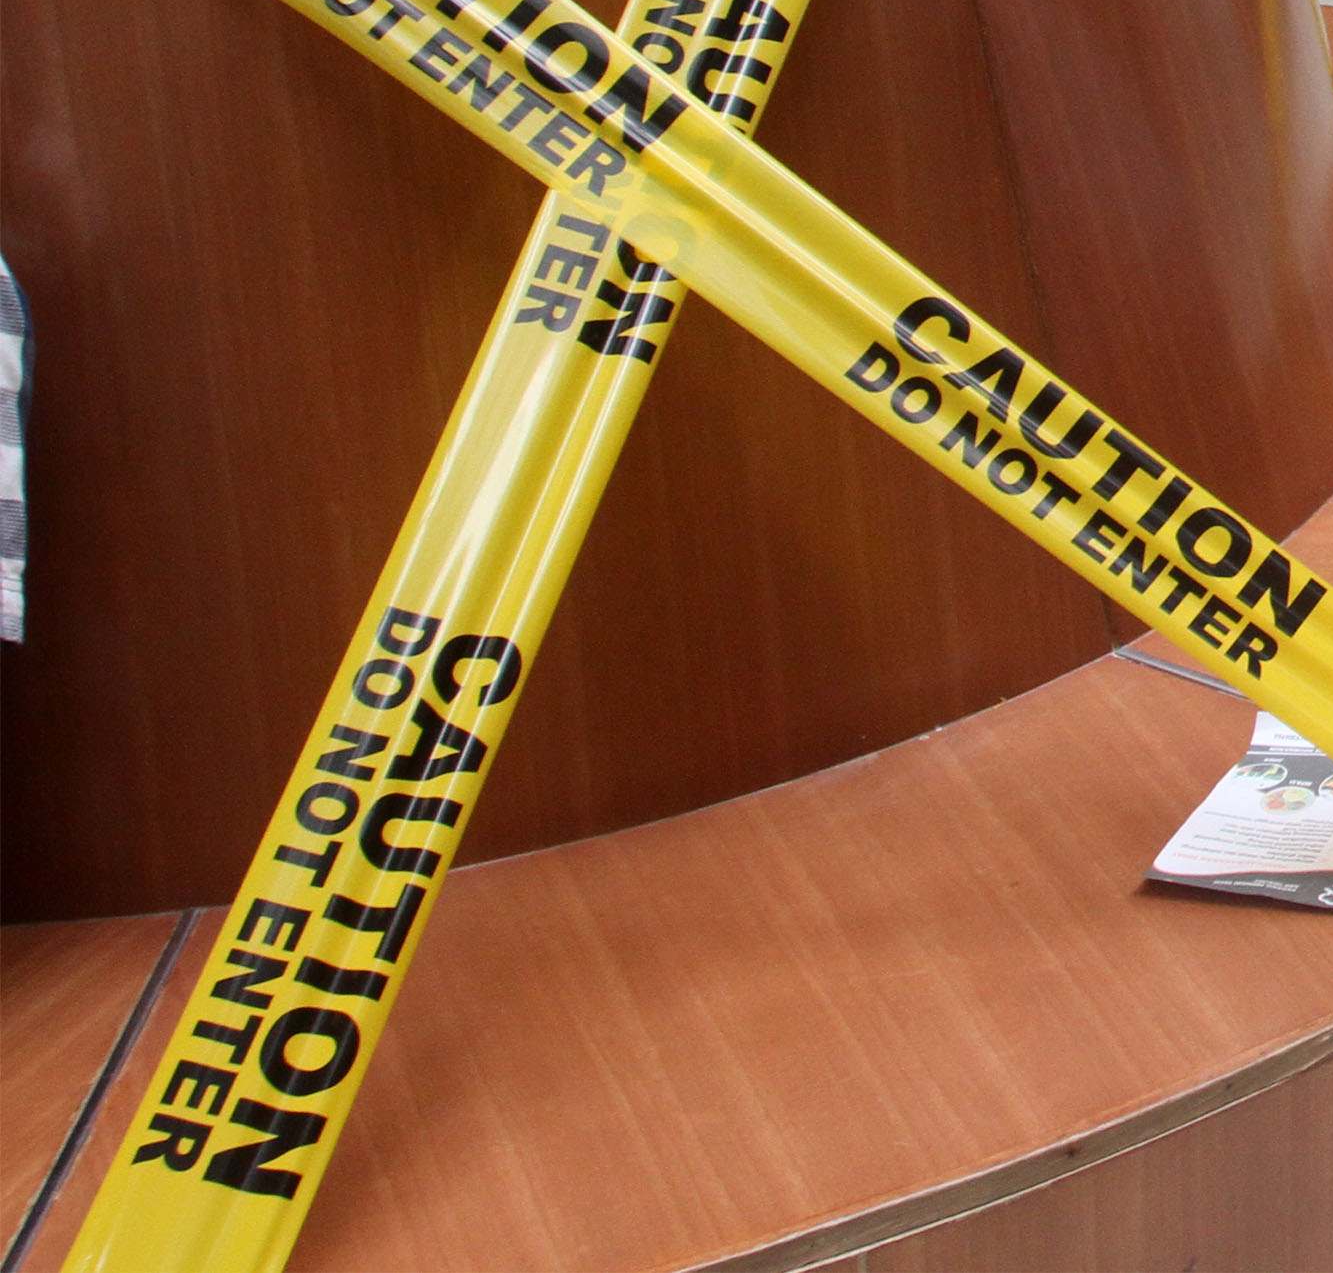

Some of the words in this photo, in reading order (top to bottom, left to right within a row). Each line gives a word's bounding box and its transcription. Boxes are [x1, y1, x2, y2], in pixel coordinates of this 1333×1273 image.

[408, 27, 628, 197] ENTER
[844, 341, 944, 424] DO
[941, 411, 1081, 521] NOT
[1070, 514, 1280, 681] ENTER
[893, 295, 1327, 638] CAUTION
[350, 606, 441, 712] DO
[202, 633, 522, 1201] CAUTION
[272, 722, 388, 888] NOT
[131, 899, 312, 1174] ENTER
